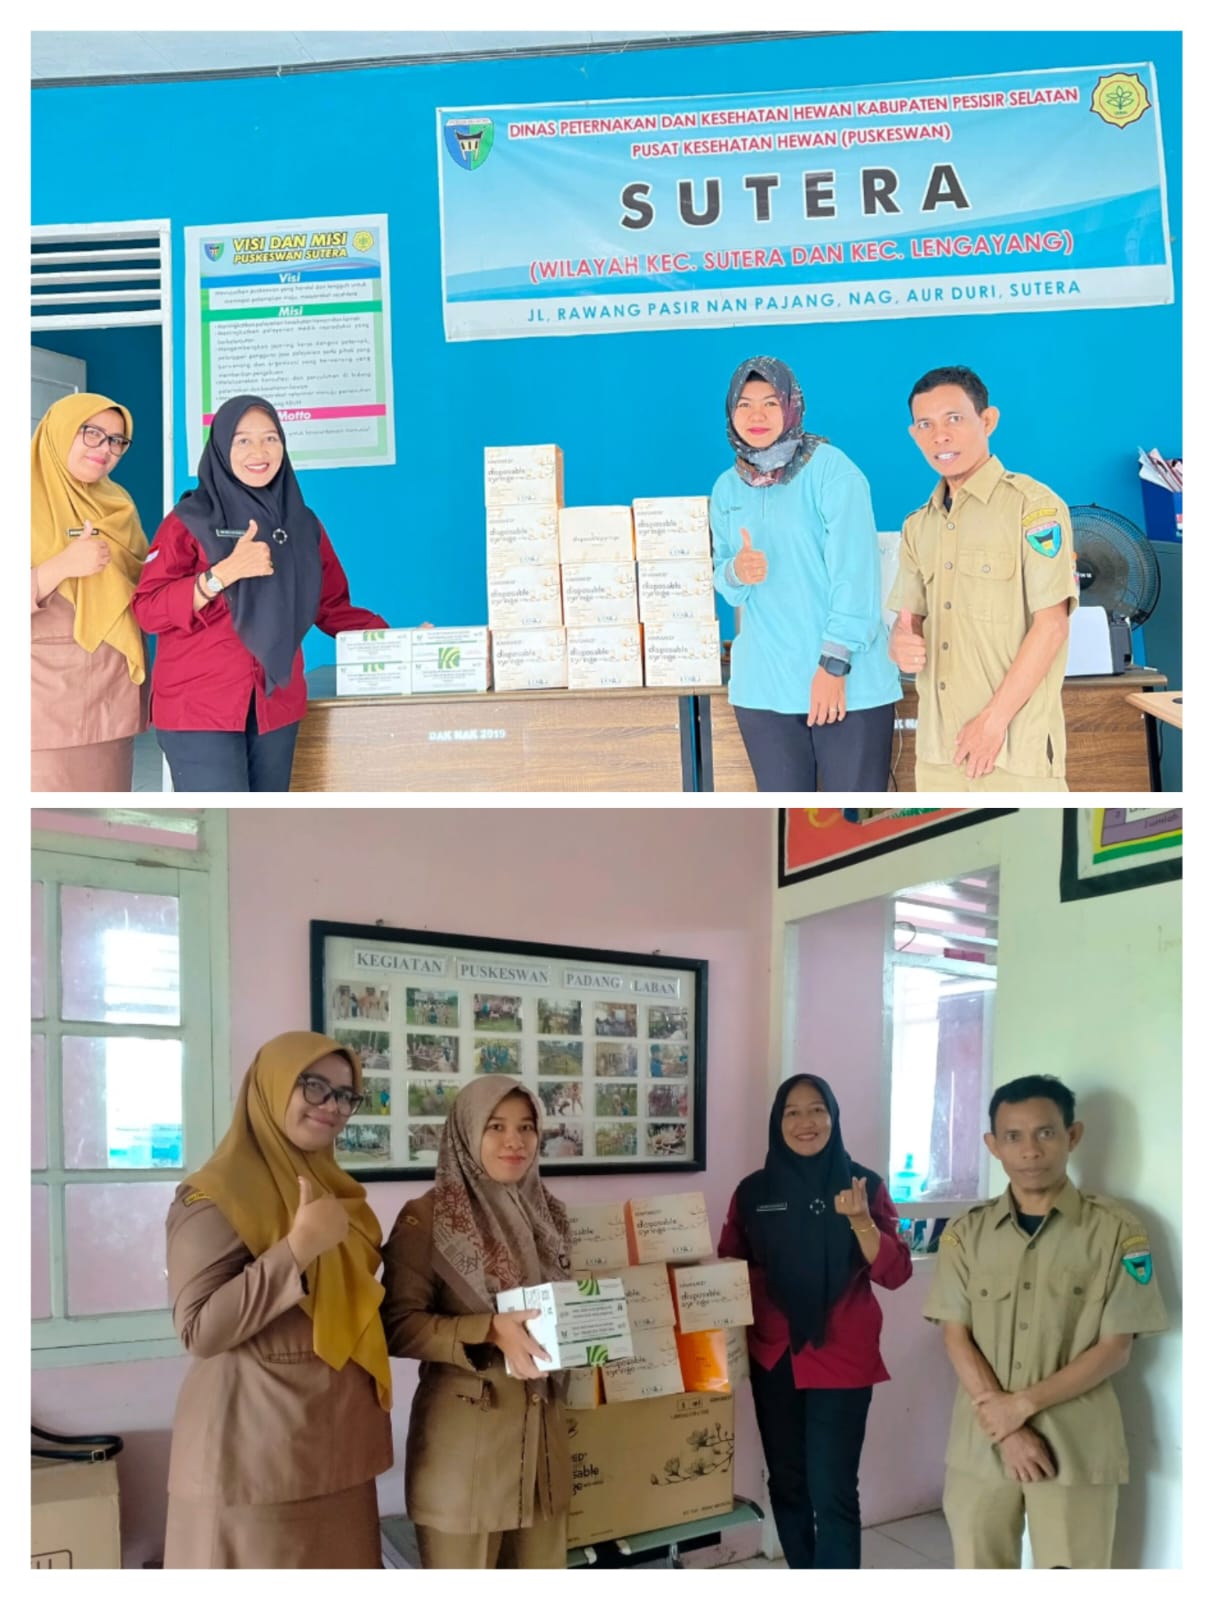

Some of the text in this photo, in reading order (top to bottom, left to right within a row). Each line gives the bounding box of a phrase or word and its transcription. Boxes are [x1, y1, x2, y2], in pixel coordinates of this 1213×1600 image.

[509, 122, 556, 138] DINAS
[560, 117, 657, 135] PETERNAKAN
[661, 114, 697, 129] DAN
[701, 106, 790, 126] KESEHATAN
[794, 103, 851, 121] HEWAN
[857, 98, 949, 116] KABUPATEN
[953, 93, 1005, 110] PESISIR
[1009, 88, 1078, 107] SELATAN
[632, 125, 951, 159] PUSAT KESEHATAN HEWAN (PUSKESWAN)
[620, 164, 970, 230] SUTERA
[233, 231, 348, 252] VISI DAN MISI
[233, 248, 347, 265] PUSKESWAN SUTERA
[529, 230, 1074, 285] (WILAYAH KEC. SUTERA DAN KEC. LENGAYANG)
[279, 272, 301, 283] Visi
[278, 305, 303, 317] Misi
[557, 304, 641, 321] RAWANG
[648, 300, 699, 316] PASIR
[707, 299, 748, 313] NAN
[755, 294, 841, 311] PAJANG,
[907, 287, 944, 303] AUR
[1010, 280, 1081, 298] SUTERA
[277, 410, 311, 421] Motto
[357, 952, 676, 994] KEGIATAN PUSKESWAN PADANG LABAN
[572, 1463, 599, 1480] sable
